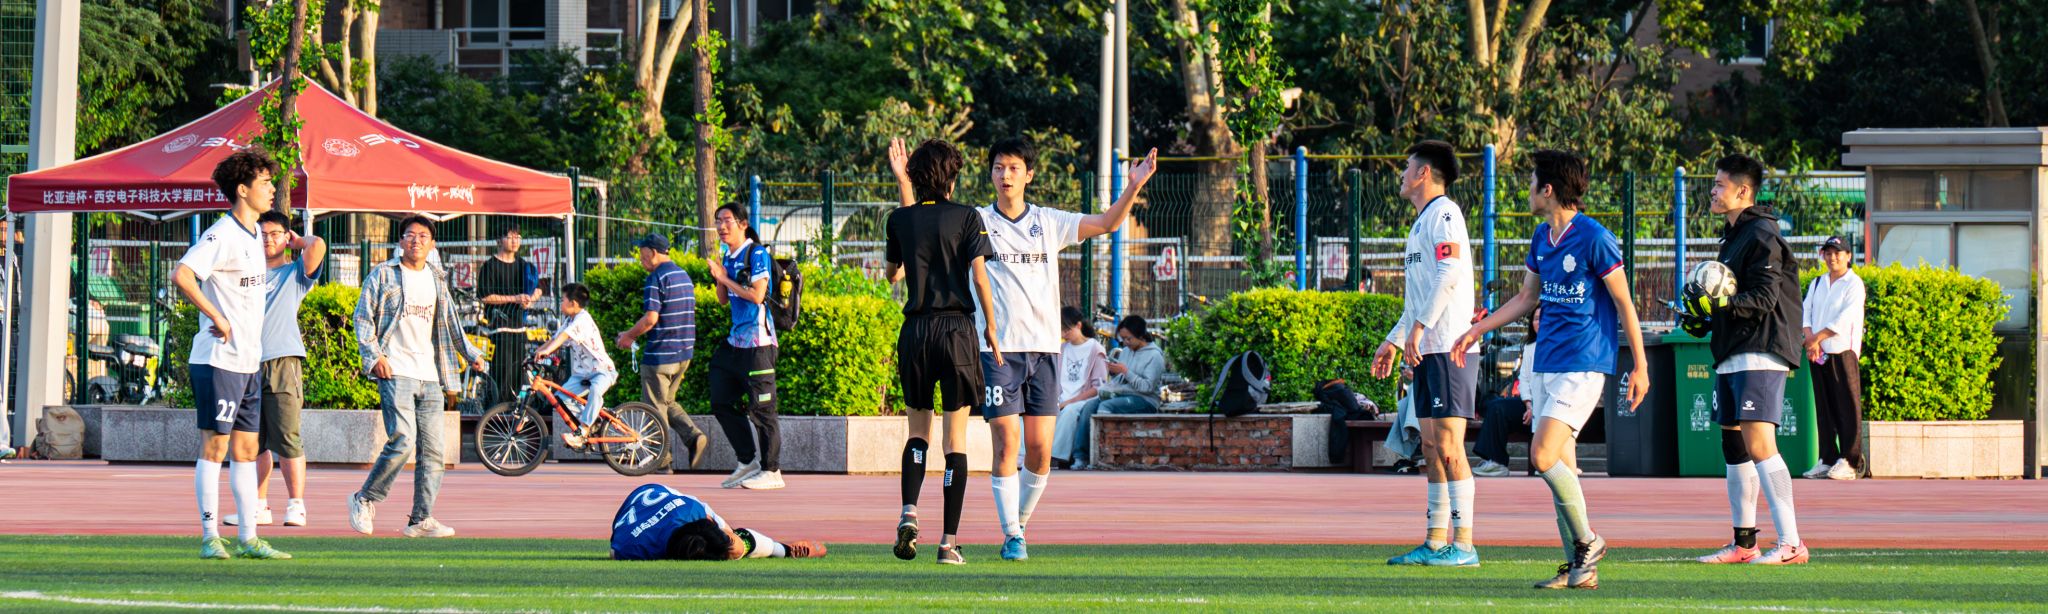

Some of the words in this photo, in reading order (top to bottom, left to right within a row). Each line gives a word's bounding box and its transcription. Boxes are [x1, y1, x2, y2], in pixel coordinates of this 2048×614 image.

[43, 188, 229, 205] 比亚迪杯·西安电子科技大学第四十五
[215, 399, 236, 423] 22
